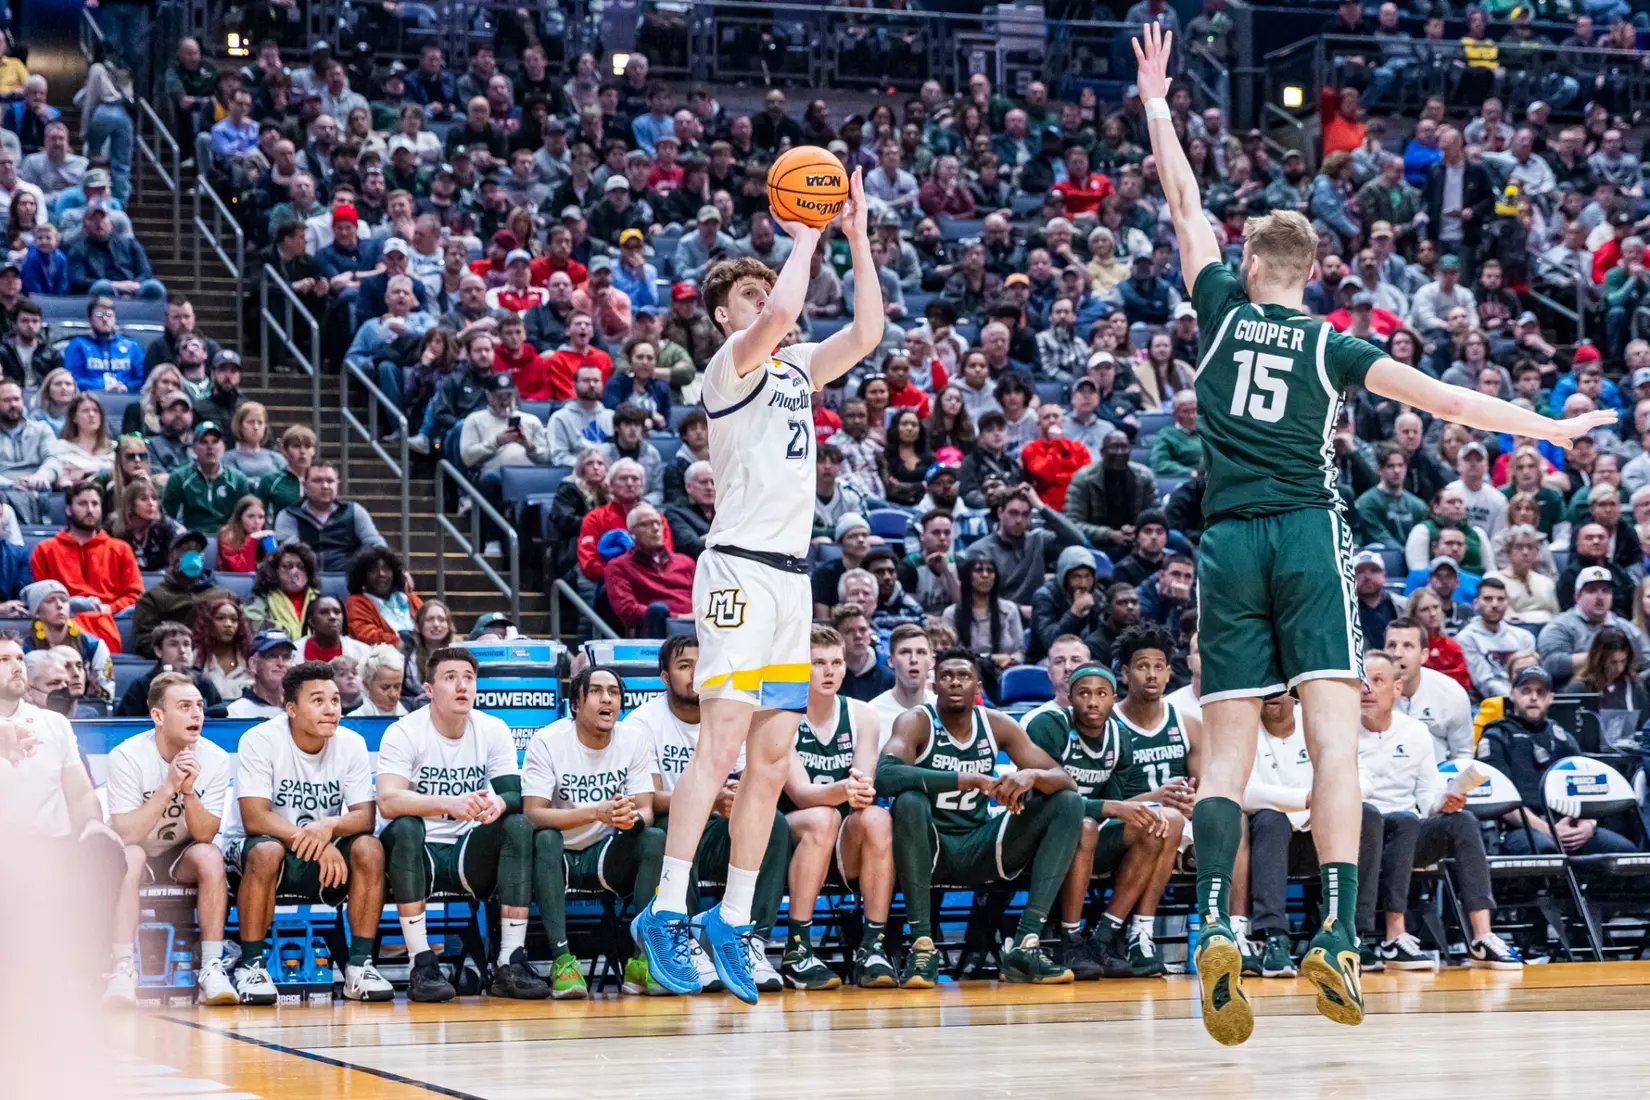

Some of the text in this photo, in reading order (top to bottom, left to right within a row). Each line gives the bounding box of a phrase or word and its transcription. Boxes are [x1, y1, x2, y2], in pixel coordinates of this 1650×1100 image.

[805, 175, 841, 188] NCAA
[796, 198, 844, 215] Wilson
[1233, 319, 1305, 352] COOPER
[1229, 349, 1295, 424] 15
[768, 388, 809, 412] Maette
[785, 419, 810, 460] 21
[705, 588, 747, 629] MU
[474, 650, 505, 658] OWERADE
[475, 691, 555, 708] POWERADE
[420, 764, 486, 781] SPARTAN
[931, 753, 993, 774] SPATANS
[561, 767, 628, 788] SPARTAN
[279, 779, 340, 796] SPARTAN
[274, 793, 341, 811] STRONG
